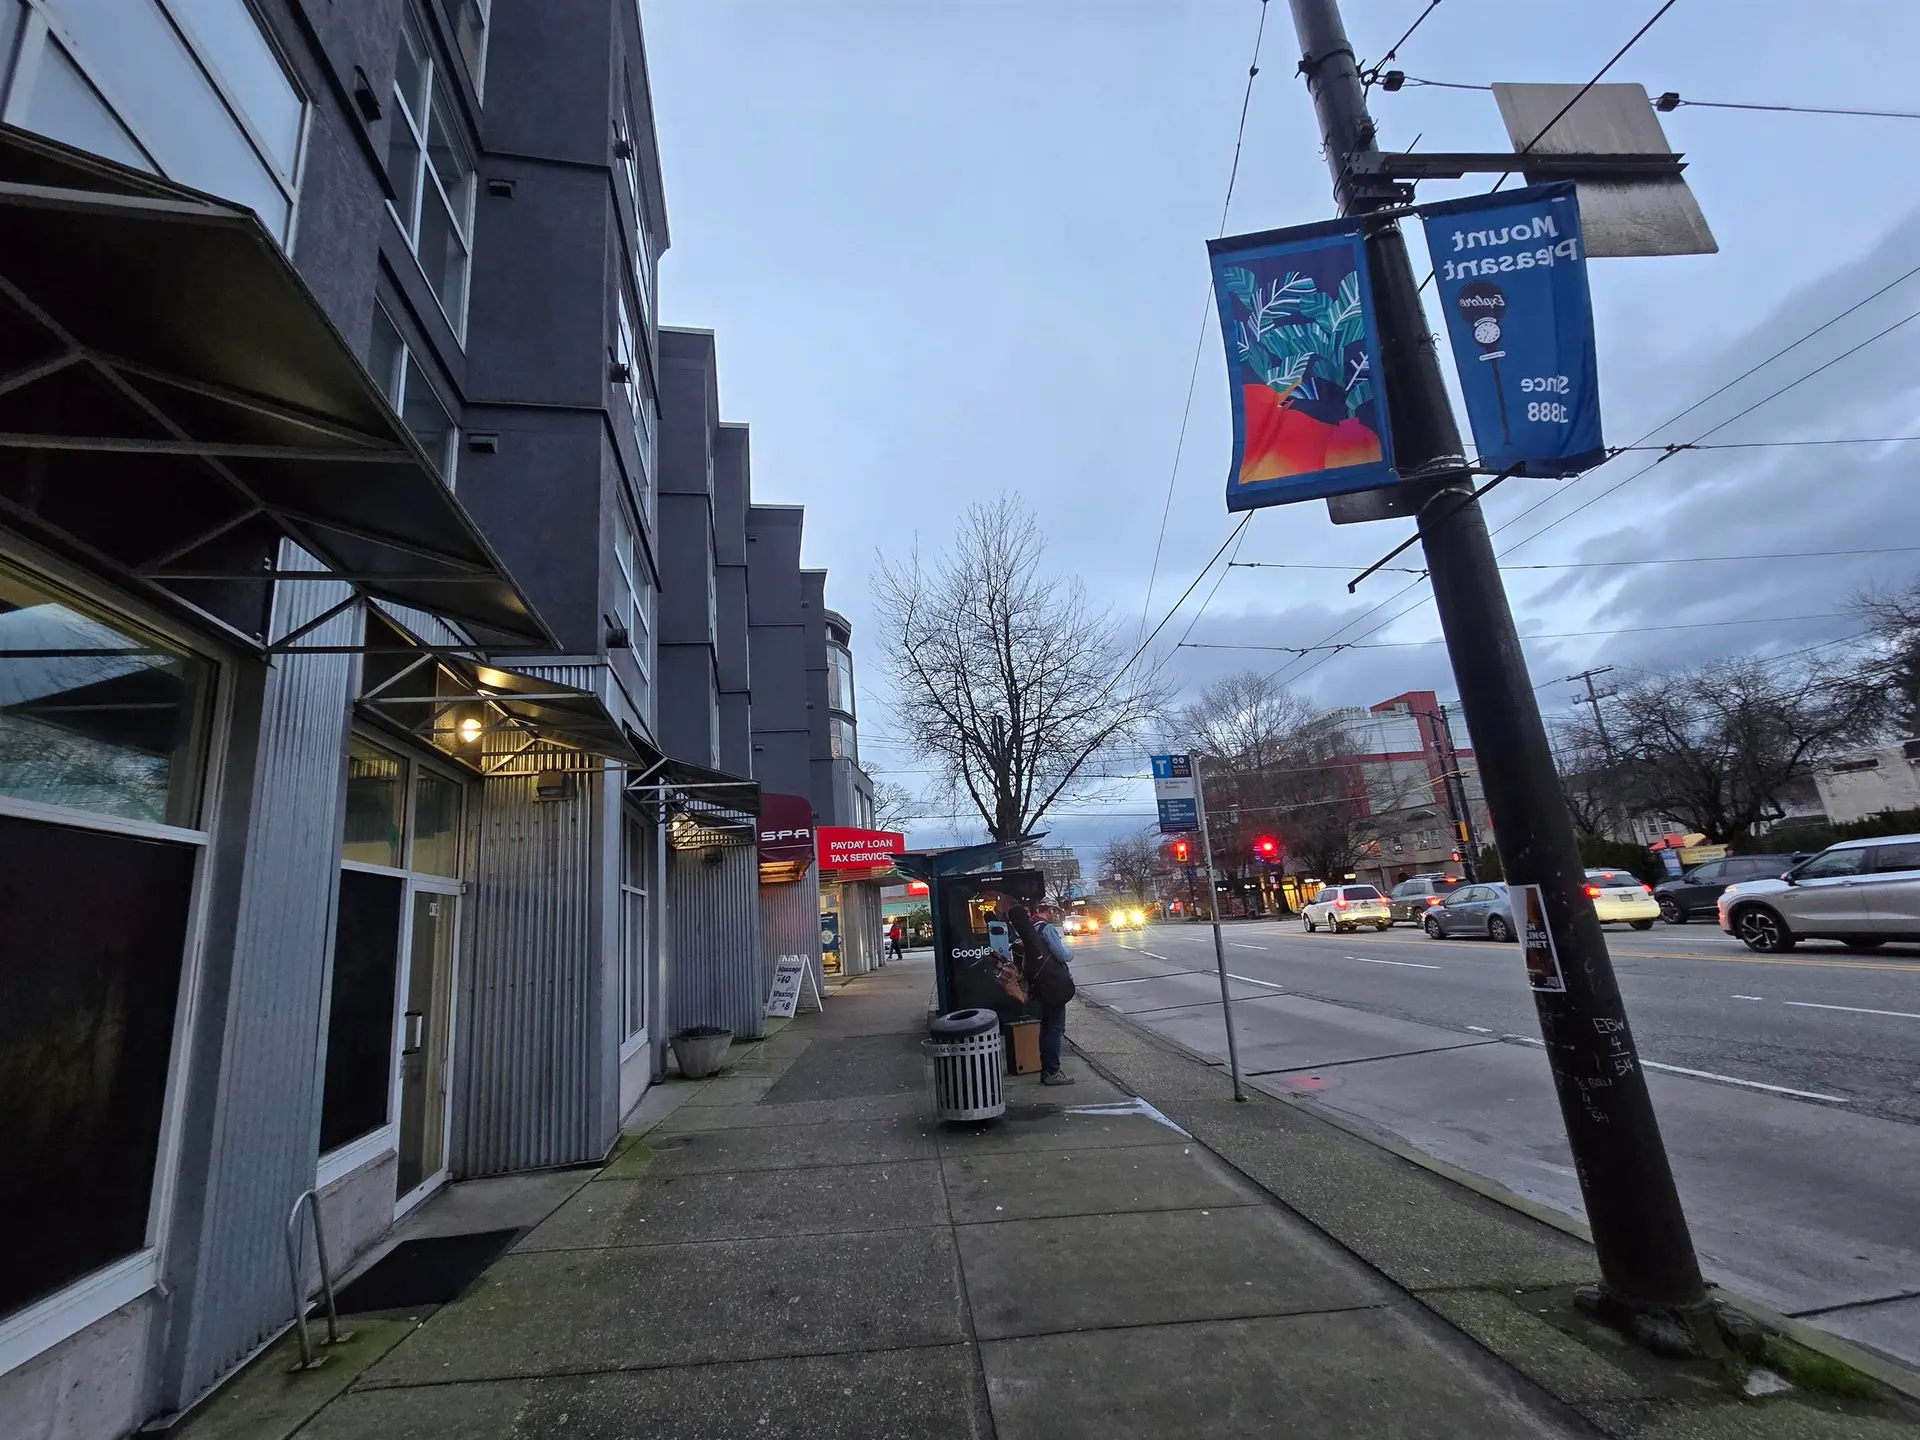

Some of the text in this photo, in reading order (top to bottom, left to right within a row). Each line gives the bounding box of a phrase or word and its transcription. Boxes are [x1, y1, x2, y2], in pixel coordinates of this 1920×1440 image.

[1156, 760, 1167, 775] T
[761, 829, 810, 841] SPA
[830, 839, 893, 850] PAYDAY LOAN
[830, 854, 849, 862] TAX
[952, 946, 990, 959] Google
